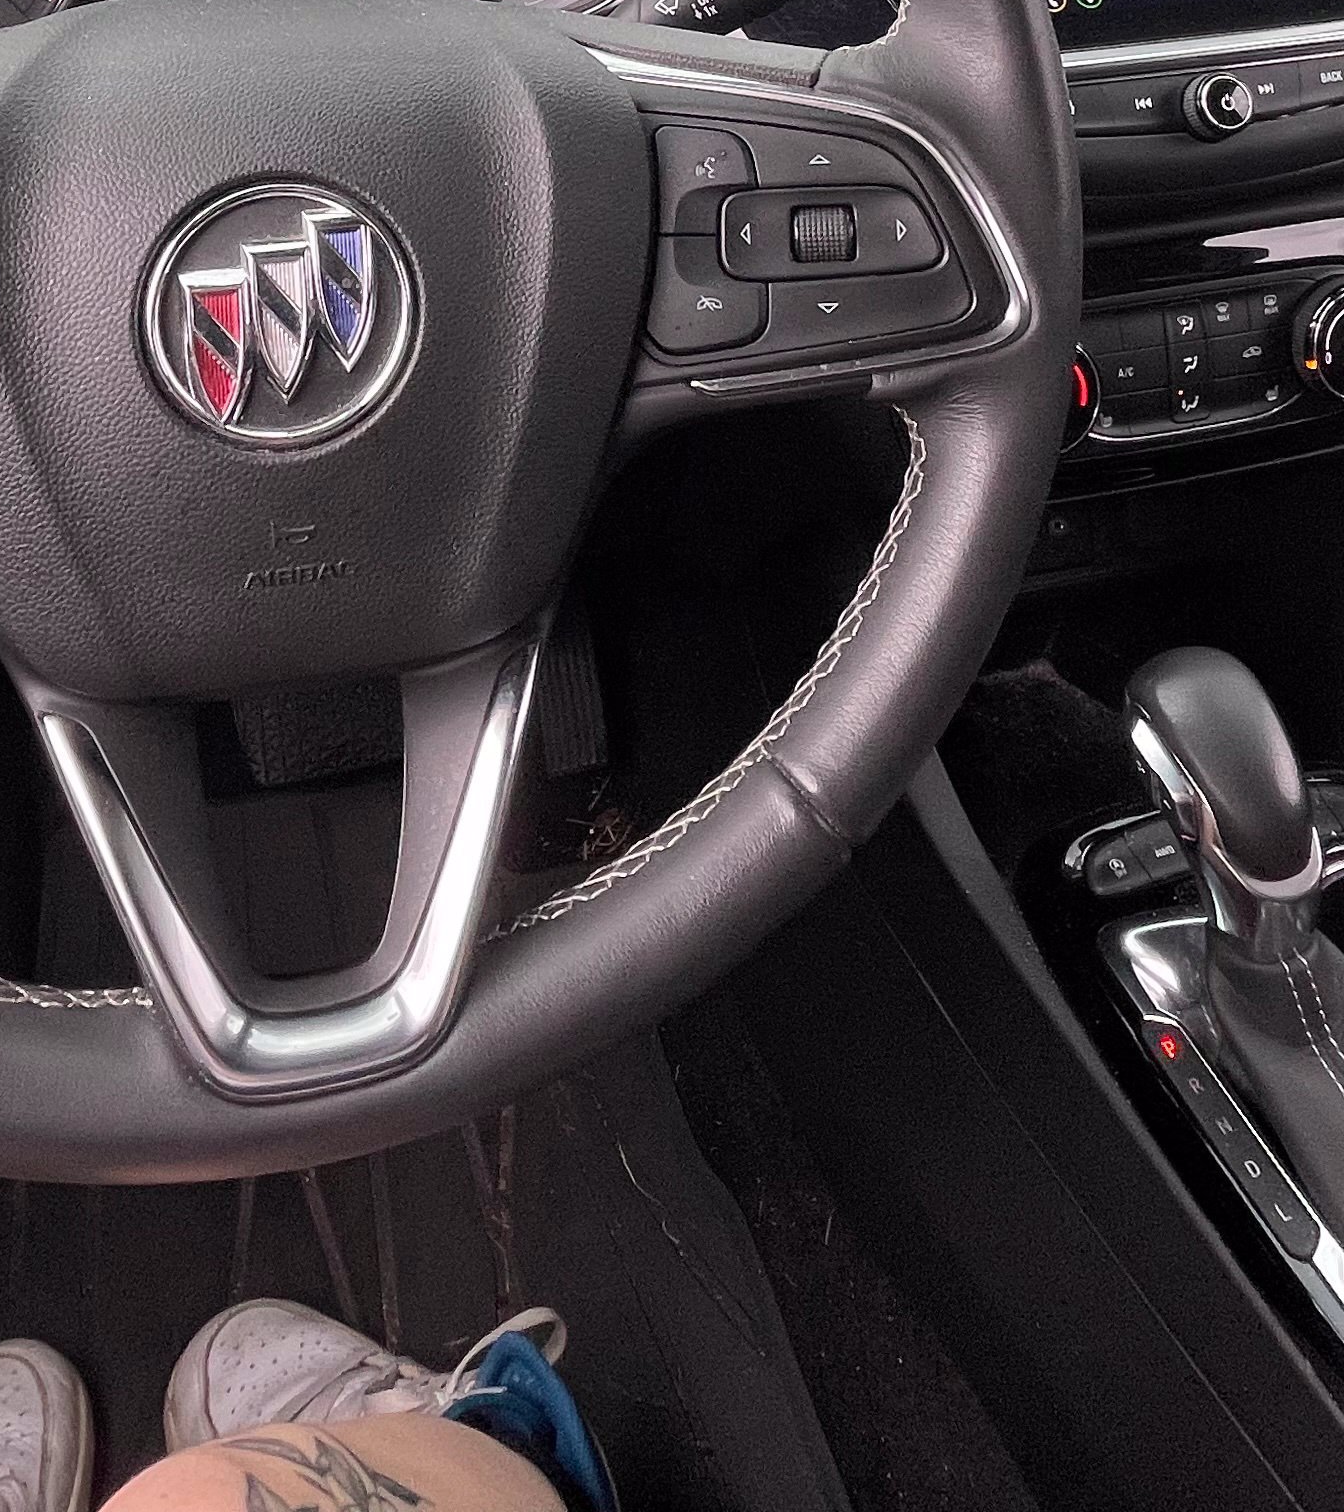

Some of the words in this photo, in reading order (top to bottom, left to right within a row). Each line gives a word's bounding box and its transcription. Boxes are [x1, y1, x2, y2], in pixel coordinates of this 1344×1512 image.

[1320, 69, 1344, 84] BACK
[1117, 366, 1135, 379] A/C
[1160, 1038, 1177, 1059] P
[1188, 1077, 1205, 1094] R
[1215, 1116, 1235, 1136] N
[1243, 1159, 1262, 1179] D
[1274, 1202, 1294, 1222] L
